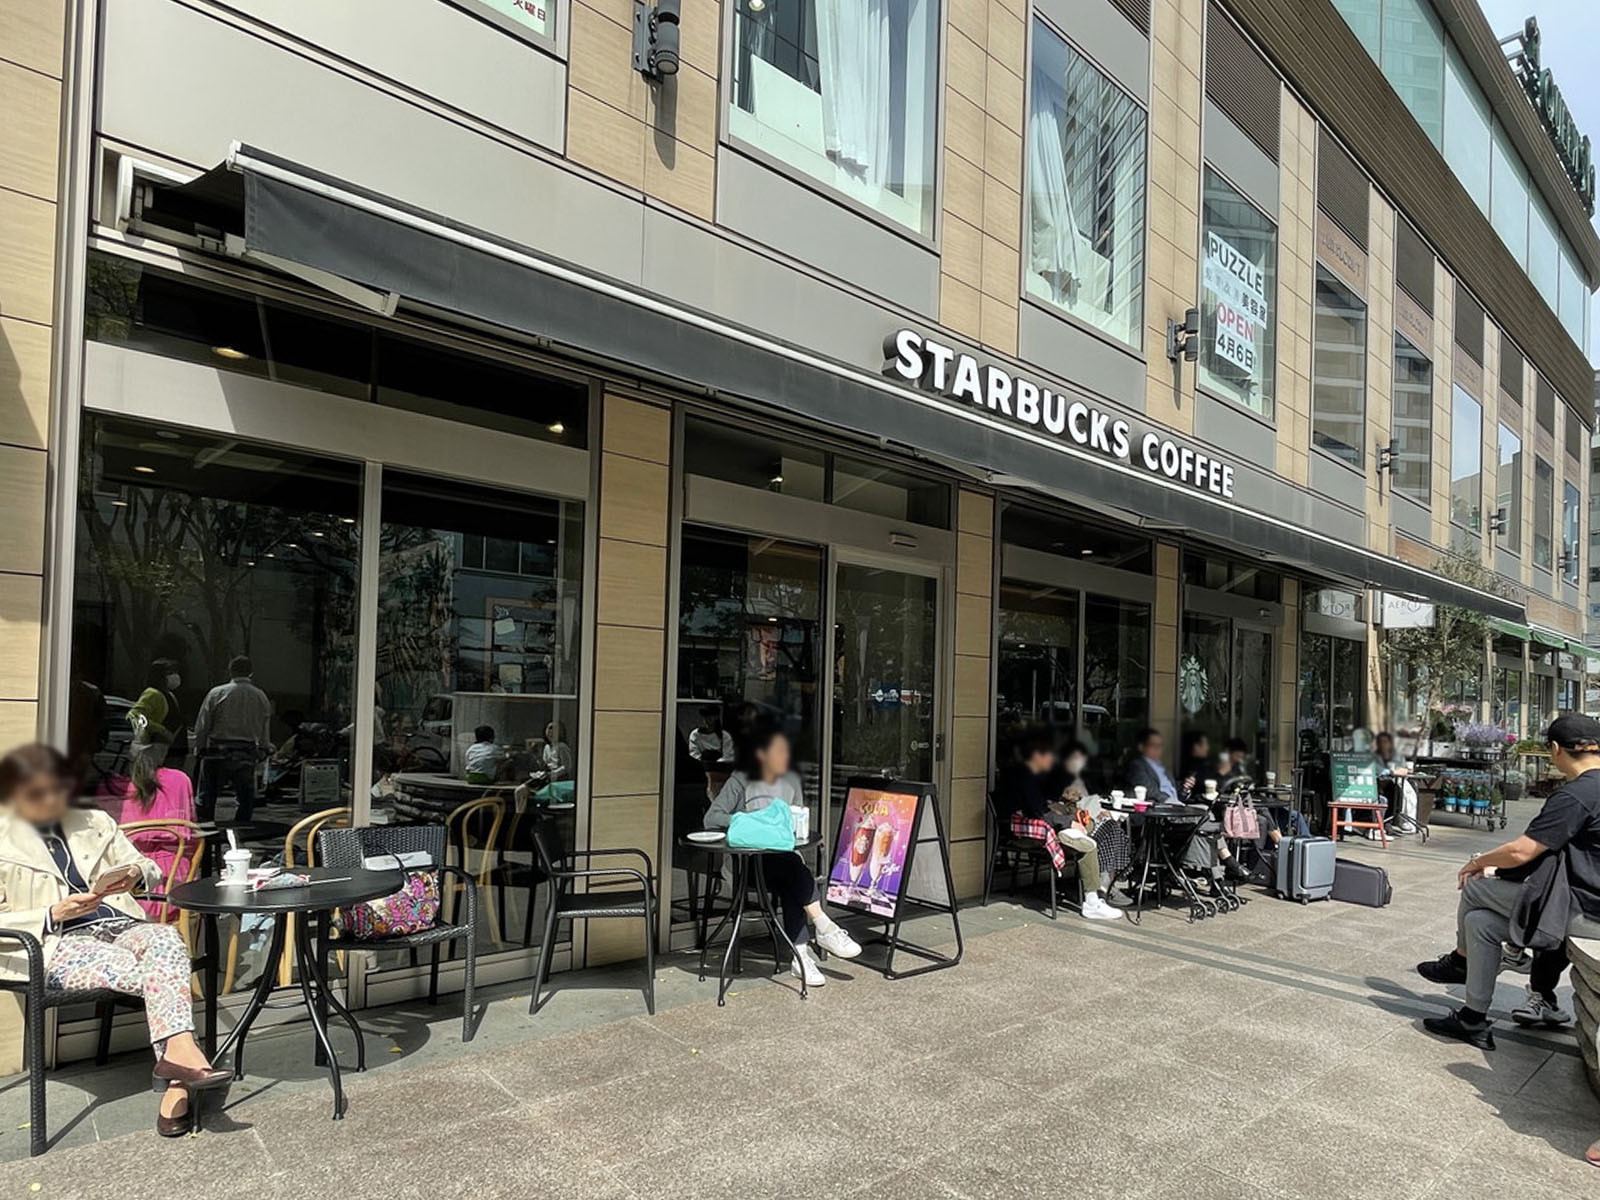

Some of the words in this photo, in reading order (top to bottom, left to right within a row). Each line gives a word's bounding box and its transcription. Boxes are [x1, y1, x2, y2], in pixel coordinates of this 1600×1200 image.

[1210, 237, 1263, 296] PUZZLE
[1216, 302, 1254, 342] OPEN
[1217, 333, 1254, 370] 4月6日
[895, 329, 1130, 459] STARBUCKS
[1142, 432, 1235, 498] COFFEE
